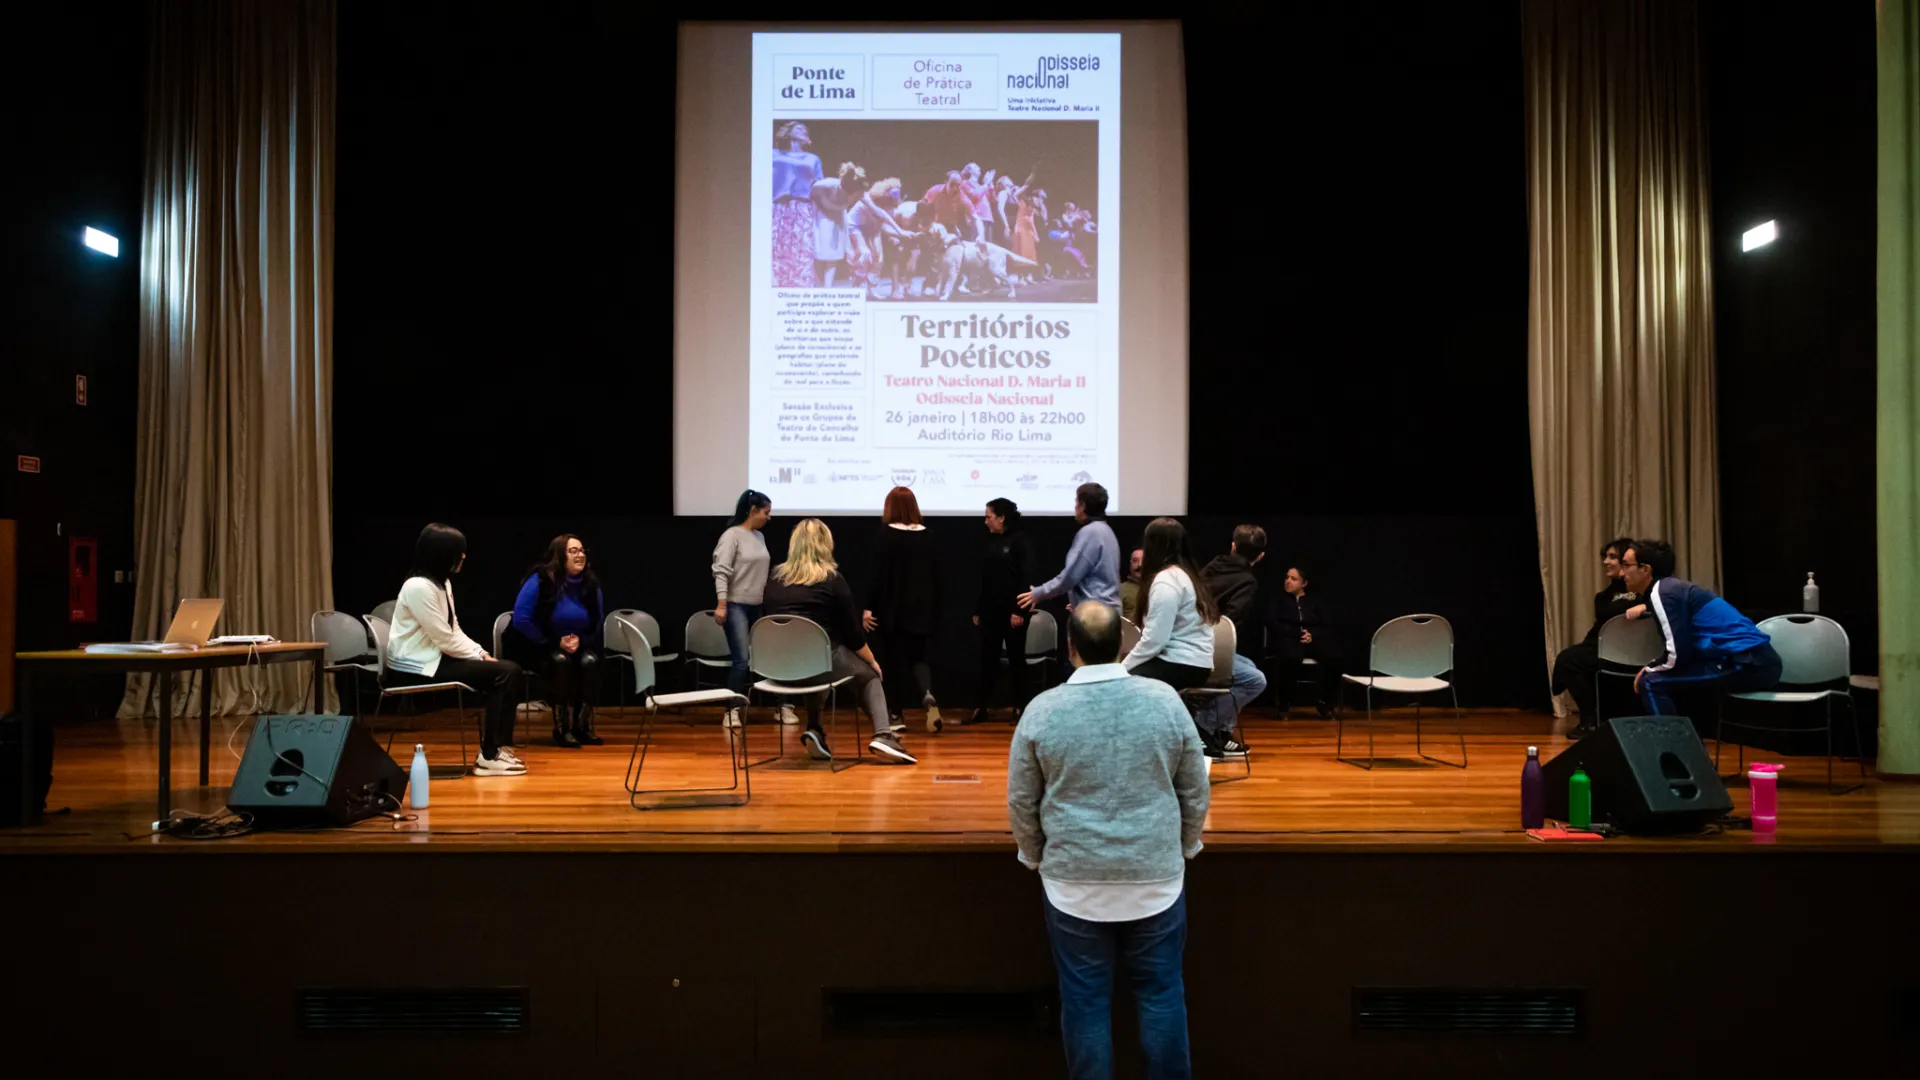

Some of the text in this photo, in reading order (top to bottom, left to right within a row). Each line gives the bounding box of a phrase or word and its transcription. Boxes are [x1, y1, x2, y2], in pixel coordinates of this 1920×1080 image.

[913, 59, 963, 73] Oficina
[792, 66, 845, 81] Ponte
[903, 76, 972, 89] de Prática
[781, 84, 856, 99] de Lima
[914, 92, 960, 105] Teatral
[900, 313, 1071, 339] Territórios
[920, 343, 1051, 368] Poéticos
[884, 374, 1086, 388] Teatro Nacional D. Maria II
[916, 392, 1054, 406] Odisseia Nacional
[814, 402, 853, 411] Exclusiva
[779, 413, 798, 422] para
[885, 411, 904, 423] 26
[907, 411, 957, 426] janeiro
[971, 411, 1016, 424] 18h00
[1019, 412, 1035, 424] às
[1040, 411, 1086, 424] 22h00
[835, 434, 855, 442] Lima
[917, 428, 1052, 442] Auditório Rio Lima
